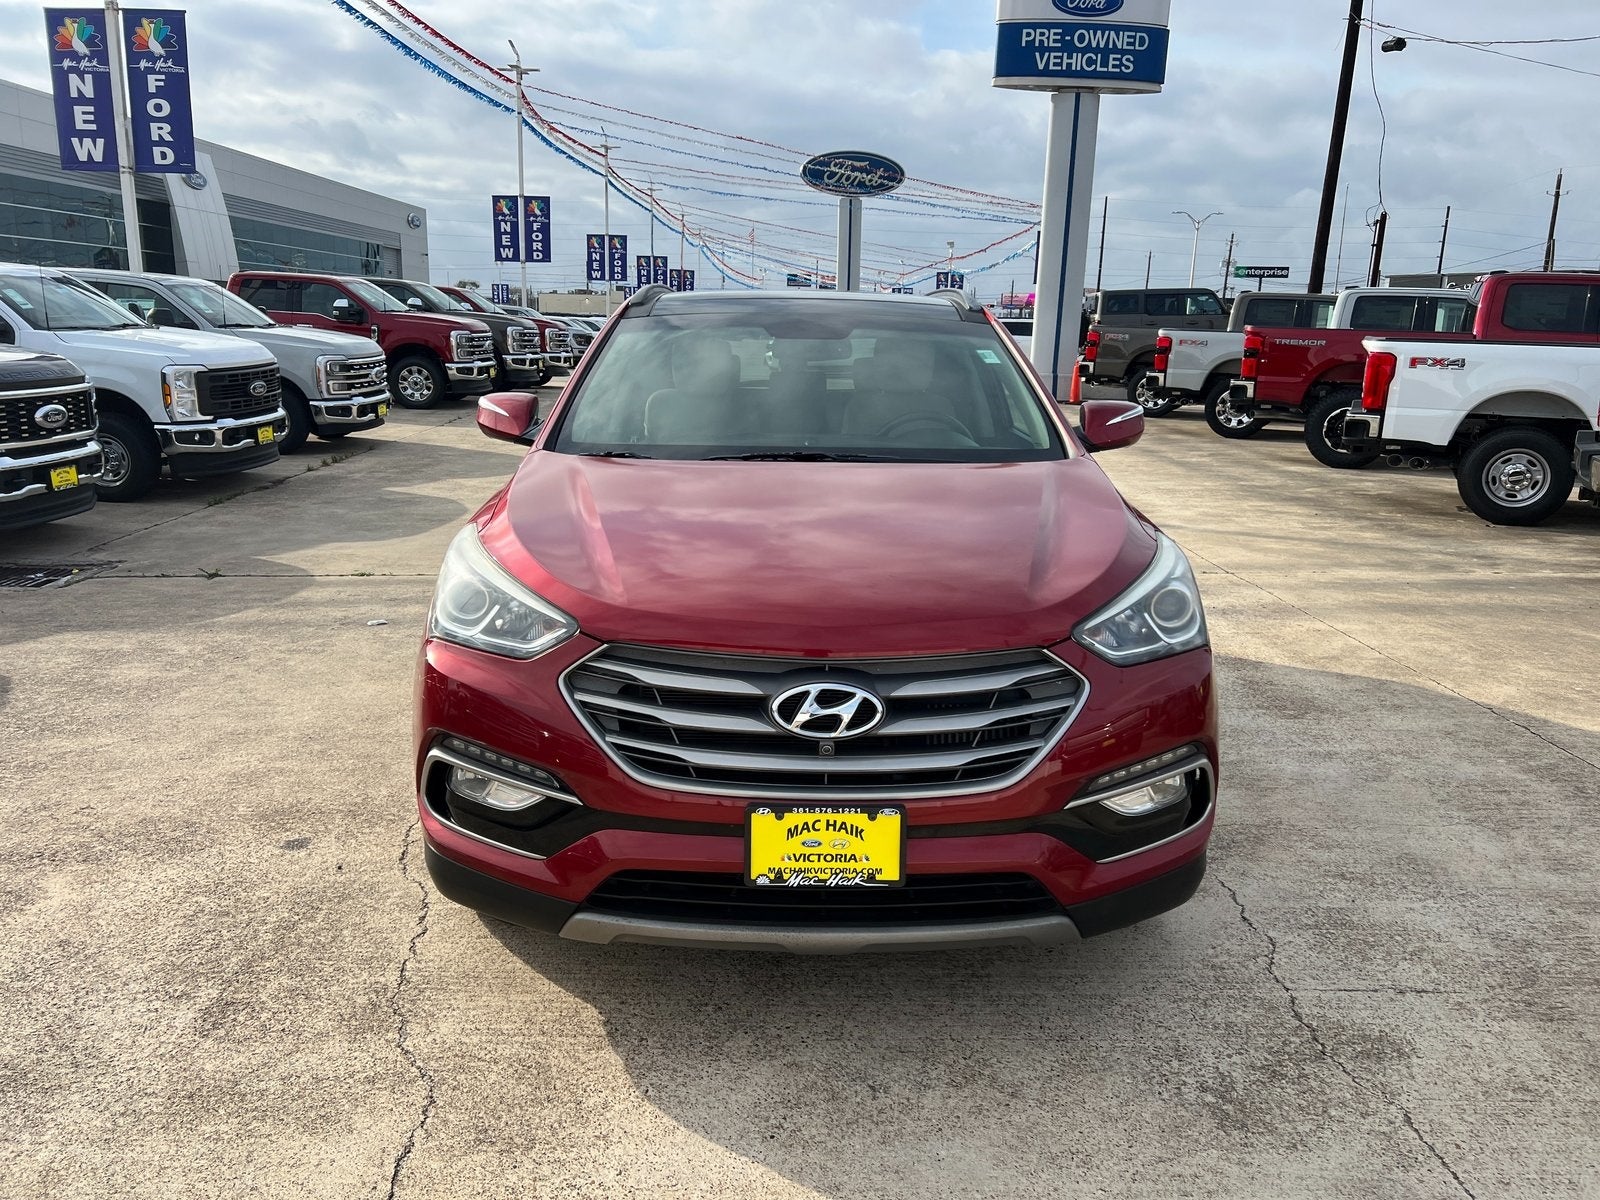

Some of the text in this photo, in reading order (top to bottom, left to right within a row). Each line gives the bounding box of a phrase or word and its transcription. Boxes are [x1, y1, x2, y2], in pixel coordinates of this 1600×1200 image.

[79, 57, 98, 71] Haik
[155, 57, 174, 71] Haik
[1035, 52, 1134, 73] VEHICLES
[68, 73, 105, 162] NEW
[146, 74, 176, 165] FORD
[823, 158, 883, 187] Ford
[500, 221, 514, 259] NEW
[531, 222, 543, 260] FORD
[591, 252, 601, 279] NEW
[613, 253, 622, 280] FORD
[1238, 267, 1289, 277] enterprise
[1273, 338, 1327, 346] TREMOR
[1408, 356, 1466, 369] FX4
[47, 411, 63, 422] Ford
[786, 819, 865, 841] MAC HAIK
[792, 853, 859, 863] VICTORIA
[785, 871, 868, 887] Mac Haik
